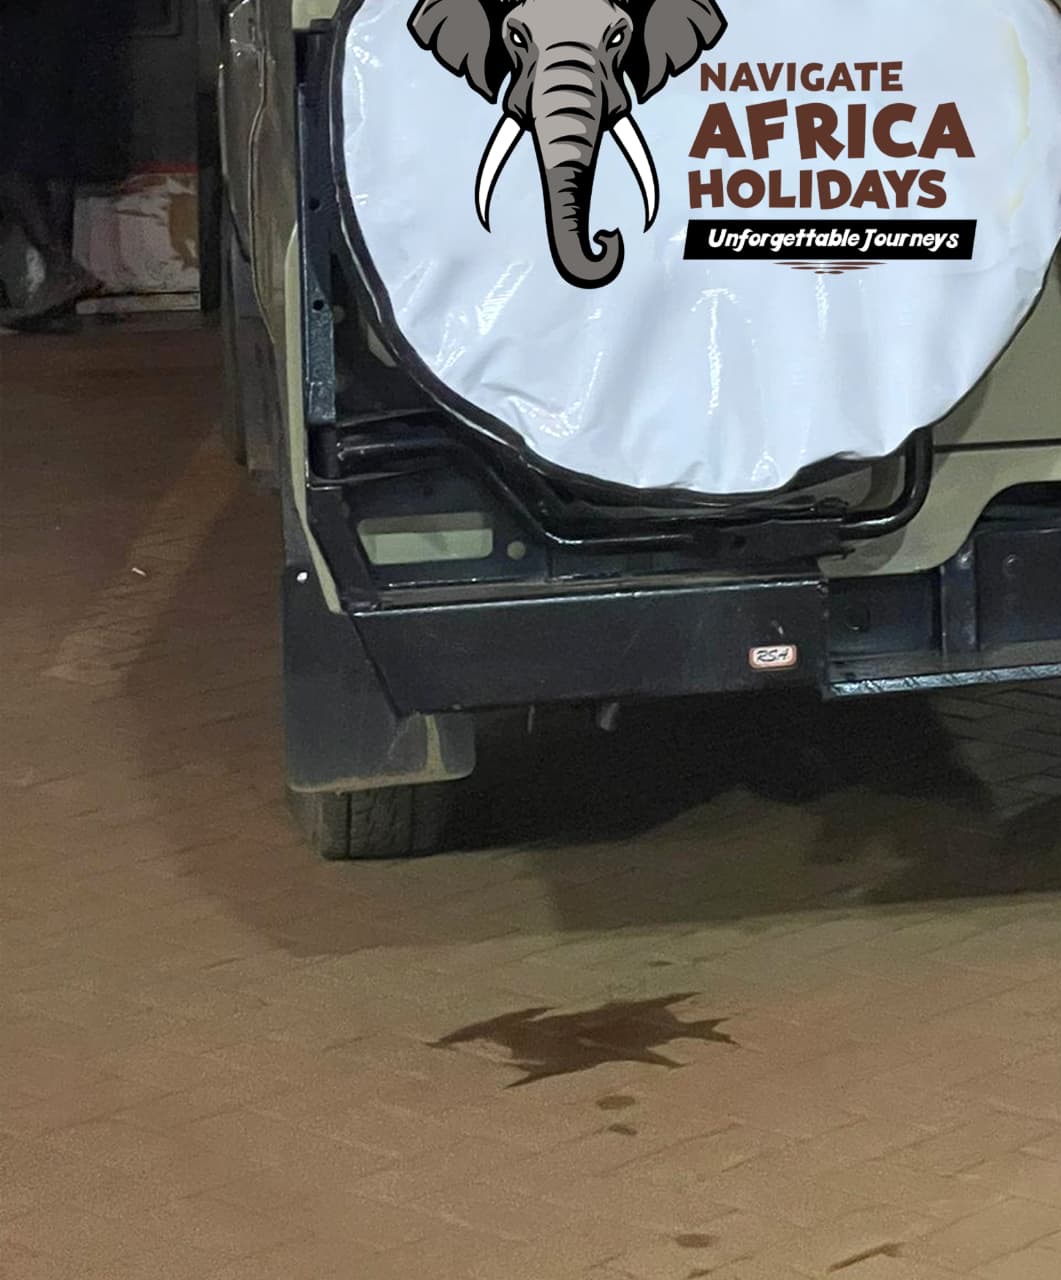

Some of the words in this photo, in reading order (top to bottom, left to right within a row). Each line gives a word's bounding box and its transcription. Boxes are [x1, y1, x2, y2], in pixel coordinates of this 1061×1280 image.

[700, 61, 903, 92] NAVIGATE
[688, 98, 976, 161] AFRICA
[688, 168, 947, 210] HOLIDAYS
[708, 228, 860, 252] Unforgettable
[862, 228, 960, 252] Journeys
